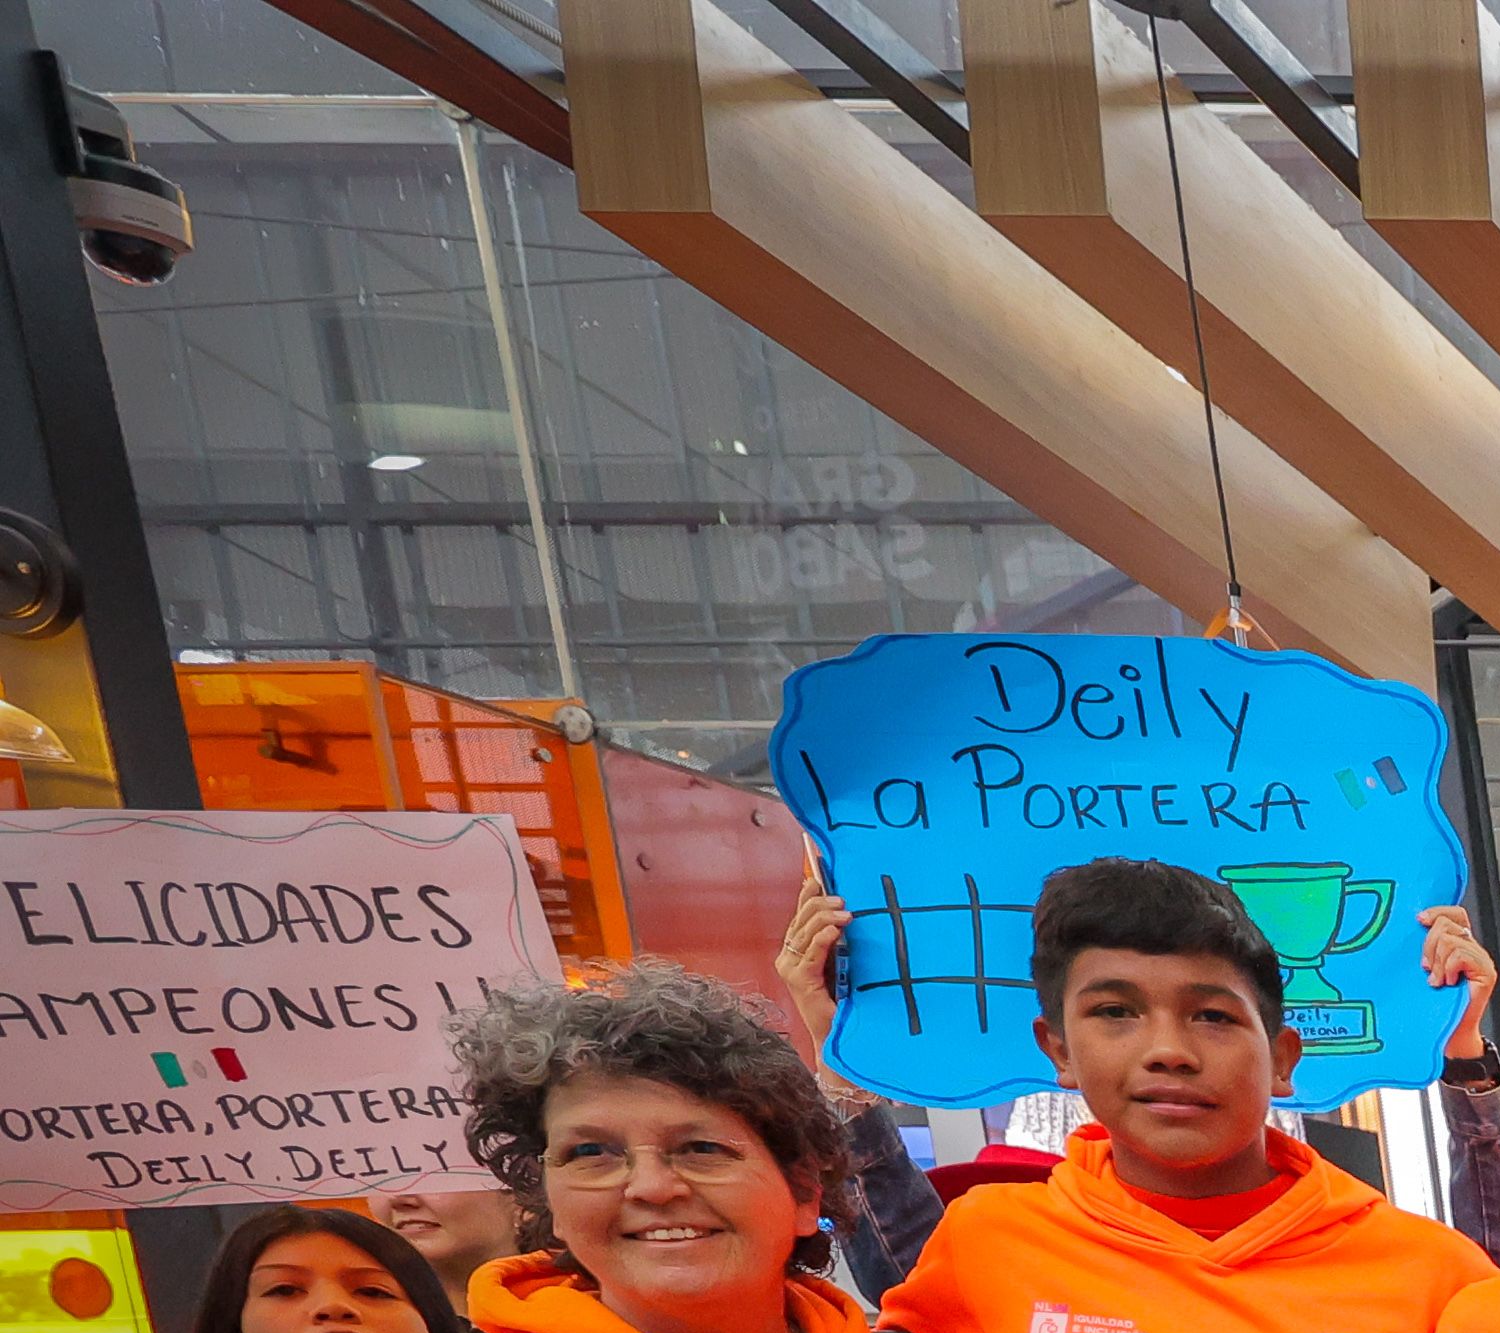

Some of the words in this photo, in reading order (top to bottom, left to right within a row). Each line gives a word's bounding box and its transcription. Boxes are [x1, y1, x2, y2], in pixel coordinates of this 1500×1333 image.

[965, 637, 1249, 772] Deily
[800, 750, 930, 832] La
[952, 744, 1310, 832] PORTERA
[2, 880, 472, 948] ELICIDADES
[0, 985, 418, 1040] AMPEONES
[1296, 1026, 1348, 1037] PEONA
[0, 1101, 214, 1142] ORTERA,
[1073, 1315, 1133, 1329] IGUALDAD
